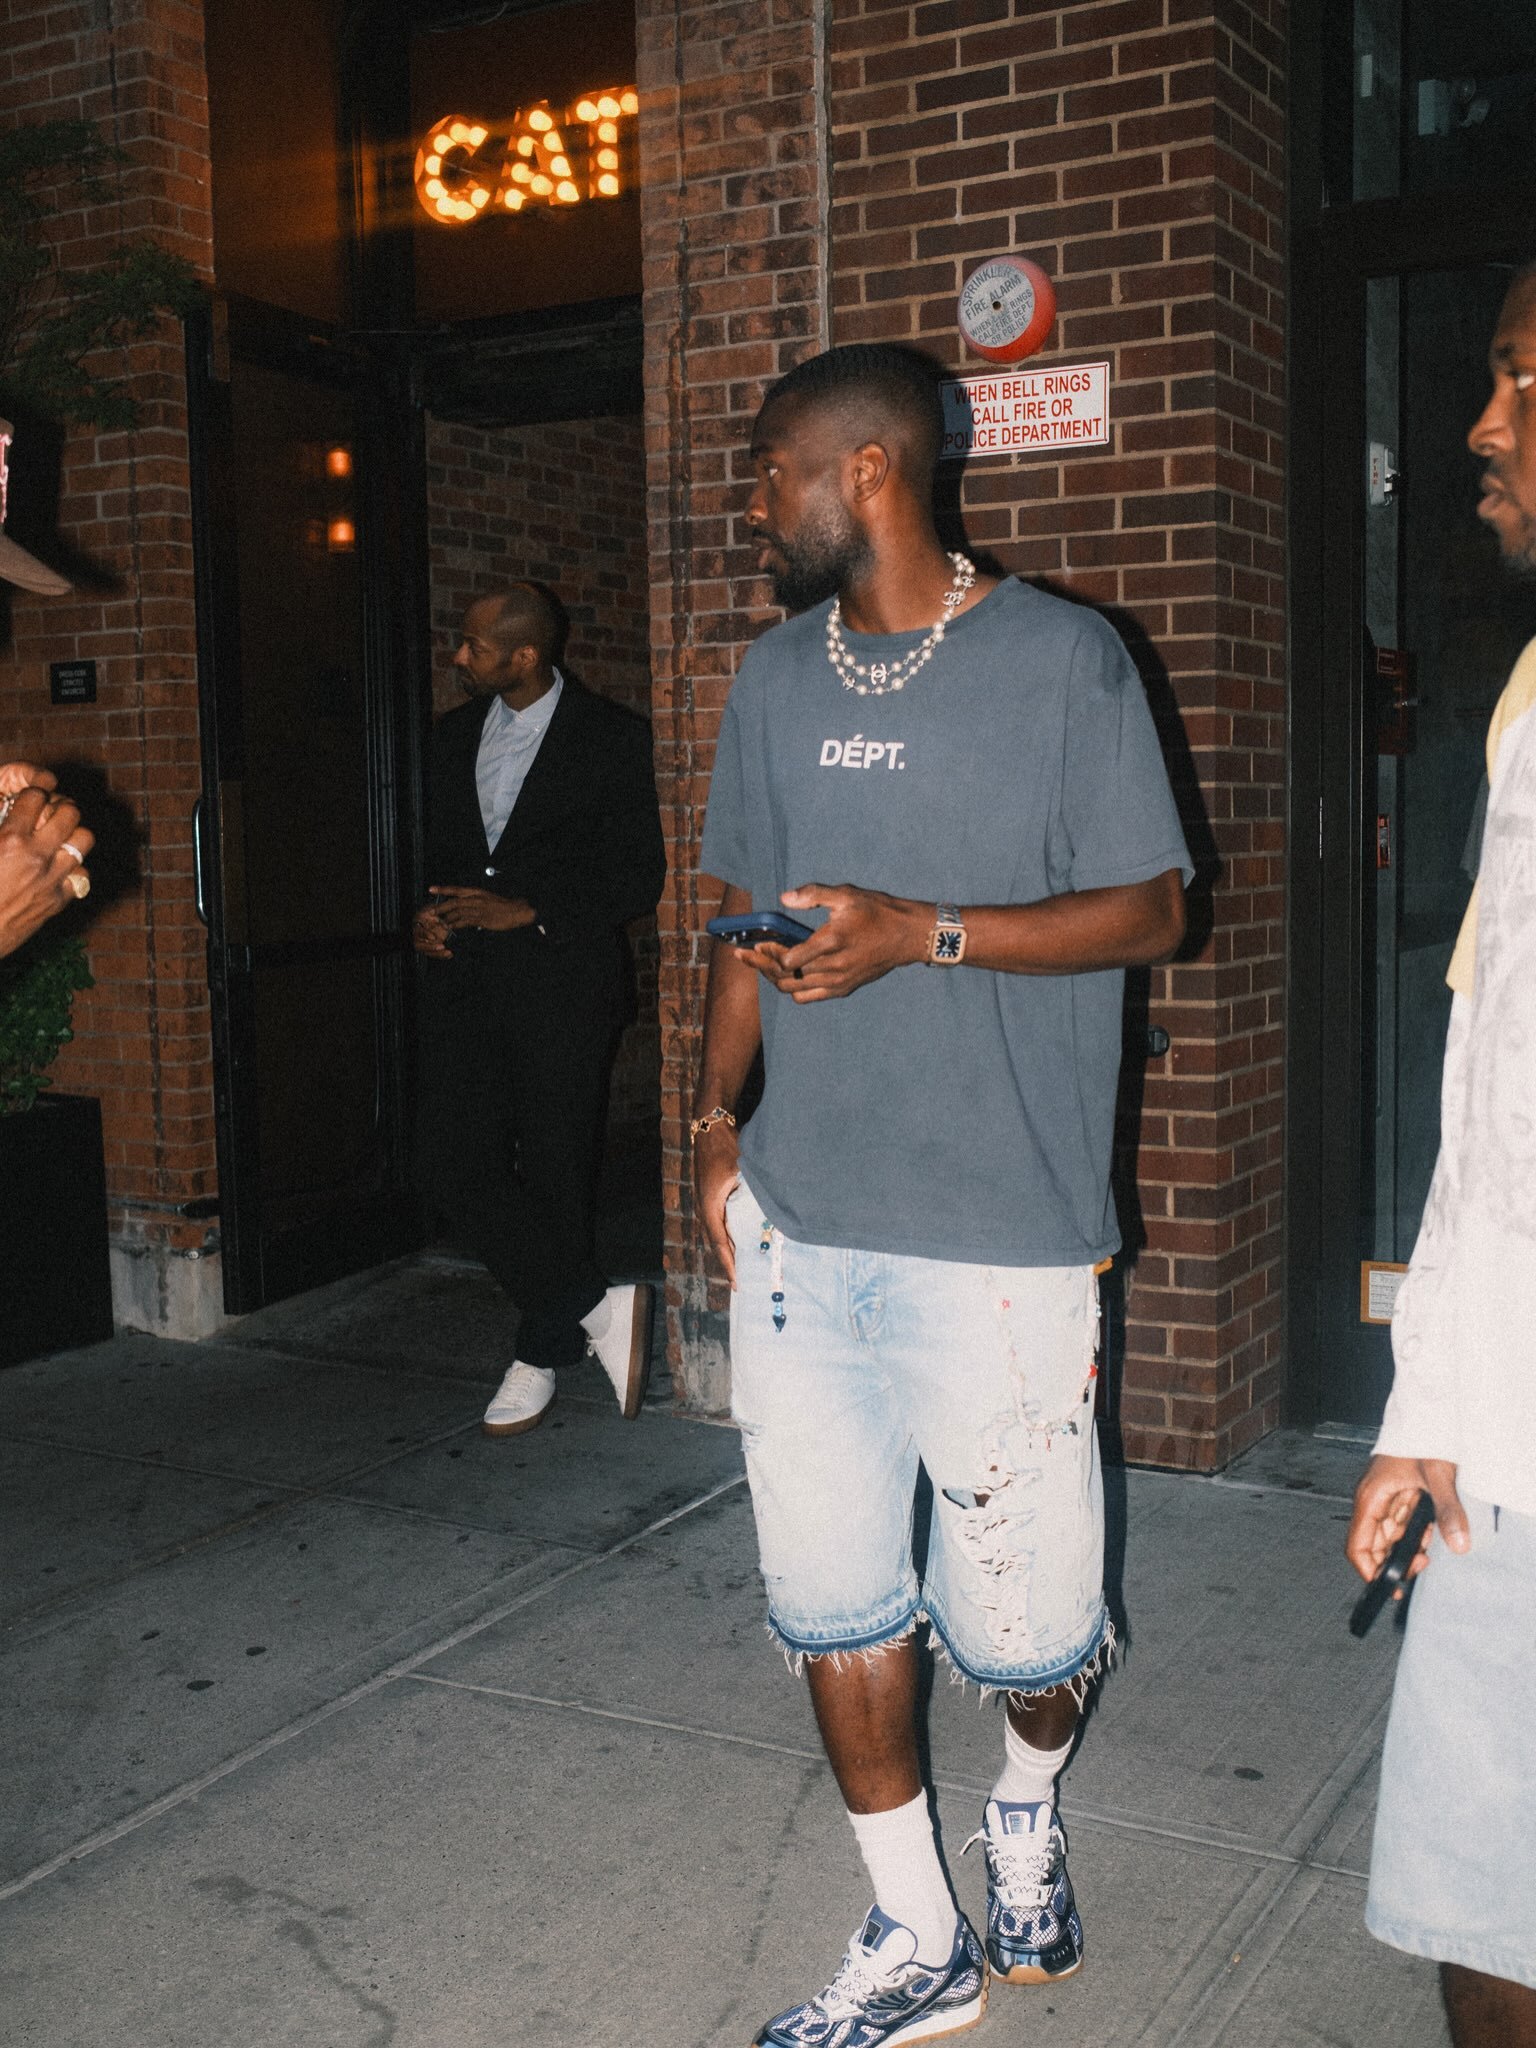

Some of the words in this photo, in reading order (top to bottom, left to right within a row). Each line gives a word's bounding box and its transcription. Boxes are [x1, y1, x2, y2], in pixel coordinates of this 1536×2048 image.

[414, 84, 638, 224] CAT
[965, 298, 989, 321] FIRE
[989, 275, 1022, 301] ALARM
[970, 319, 992, 337] WHEN
[1009, 288, 1033, 310] RINGS
[991, 333, 1002, 345] OR
[1002, 315, 1028, 337] POLICE
[954, 385, 997, 404] WHEN
[1002, 379, 1040, 401] BELL
[1044, 373, 1091, 396] RINGS
[971, 407, 1009, 426] CALL
[1014, 401, 1046, 422] FIRE
[1051, 398, 1073, 417] OR
[945, 428, 997, 450] POLICE
[1001, 418, 1102, 445] DEPARTMENT
[819, 734, 905, 769] DÉPT.
